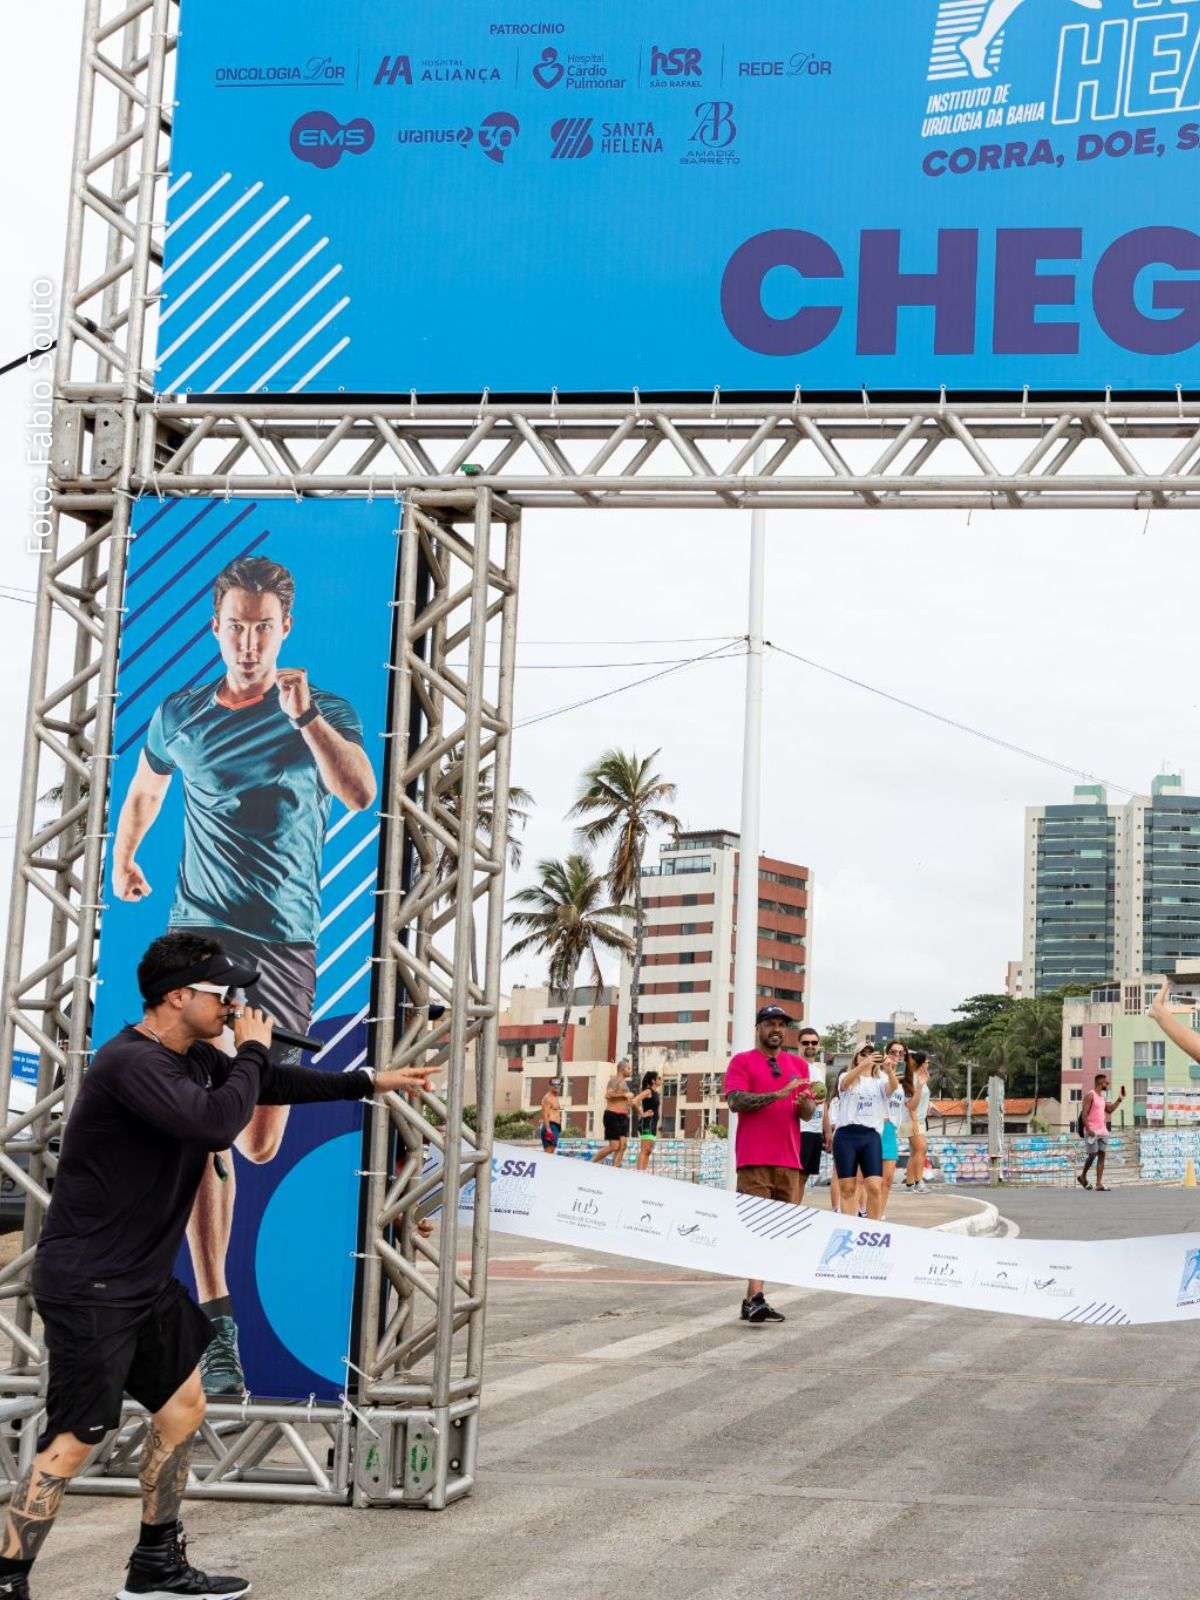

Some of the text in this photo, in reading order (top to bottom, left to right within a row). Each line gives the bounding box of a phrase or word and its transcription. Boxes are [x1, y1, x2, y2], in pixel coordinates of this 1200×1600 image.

[489, 23, 565, 35] PATROCÍNIO
[567, 54, 604, 64] Hospital
[215, 67, 301, 80] ONCOLOGIA
[421, 68, 501, 84] ALIANÇA
[567, 65, 608, 77] Cardio
[738, 61, 784, 77] REDE
[566, 77, 626, 89] Pulmonar
[650, 80, 667, 88] SÃO
[926, 84, 1012, 114] INSTITUTO DE
[921, 101, 1046, 138] UROLOGIA DA BAHIA
[602, 122, 655, 137] SANTA
[299, 129, 365, 146] EMS
[601, 138, 664, 153] HELENA
[921, 140, 1065, 177] CORRA,
[1076, 127, 1165, 162] DOE,
[501, 1160, 537, 1178] SSA
[856, 1231, 891, 1248] SSA
